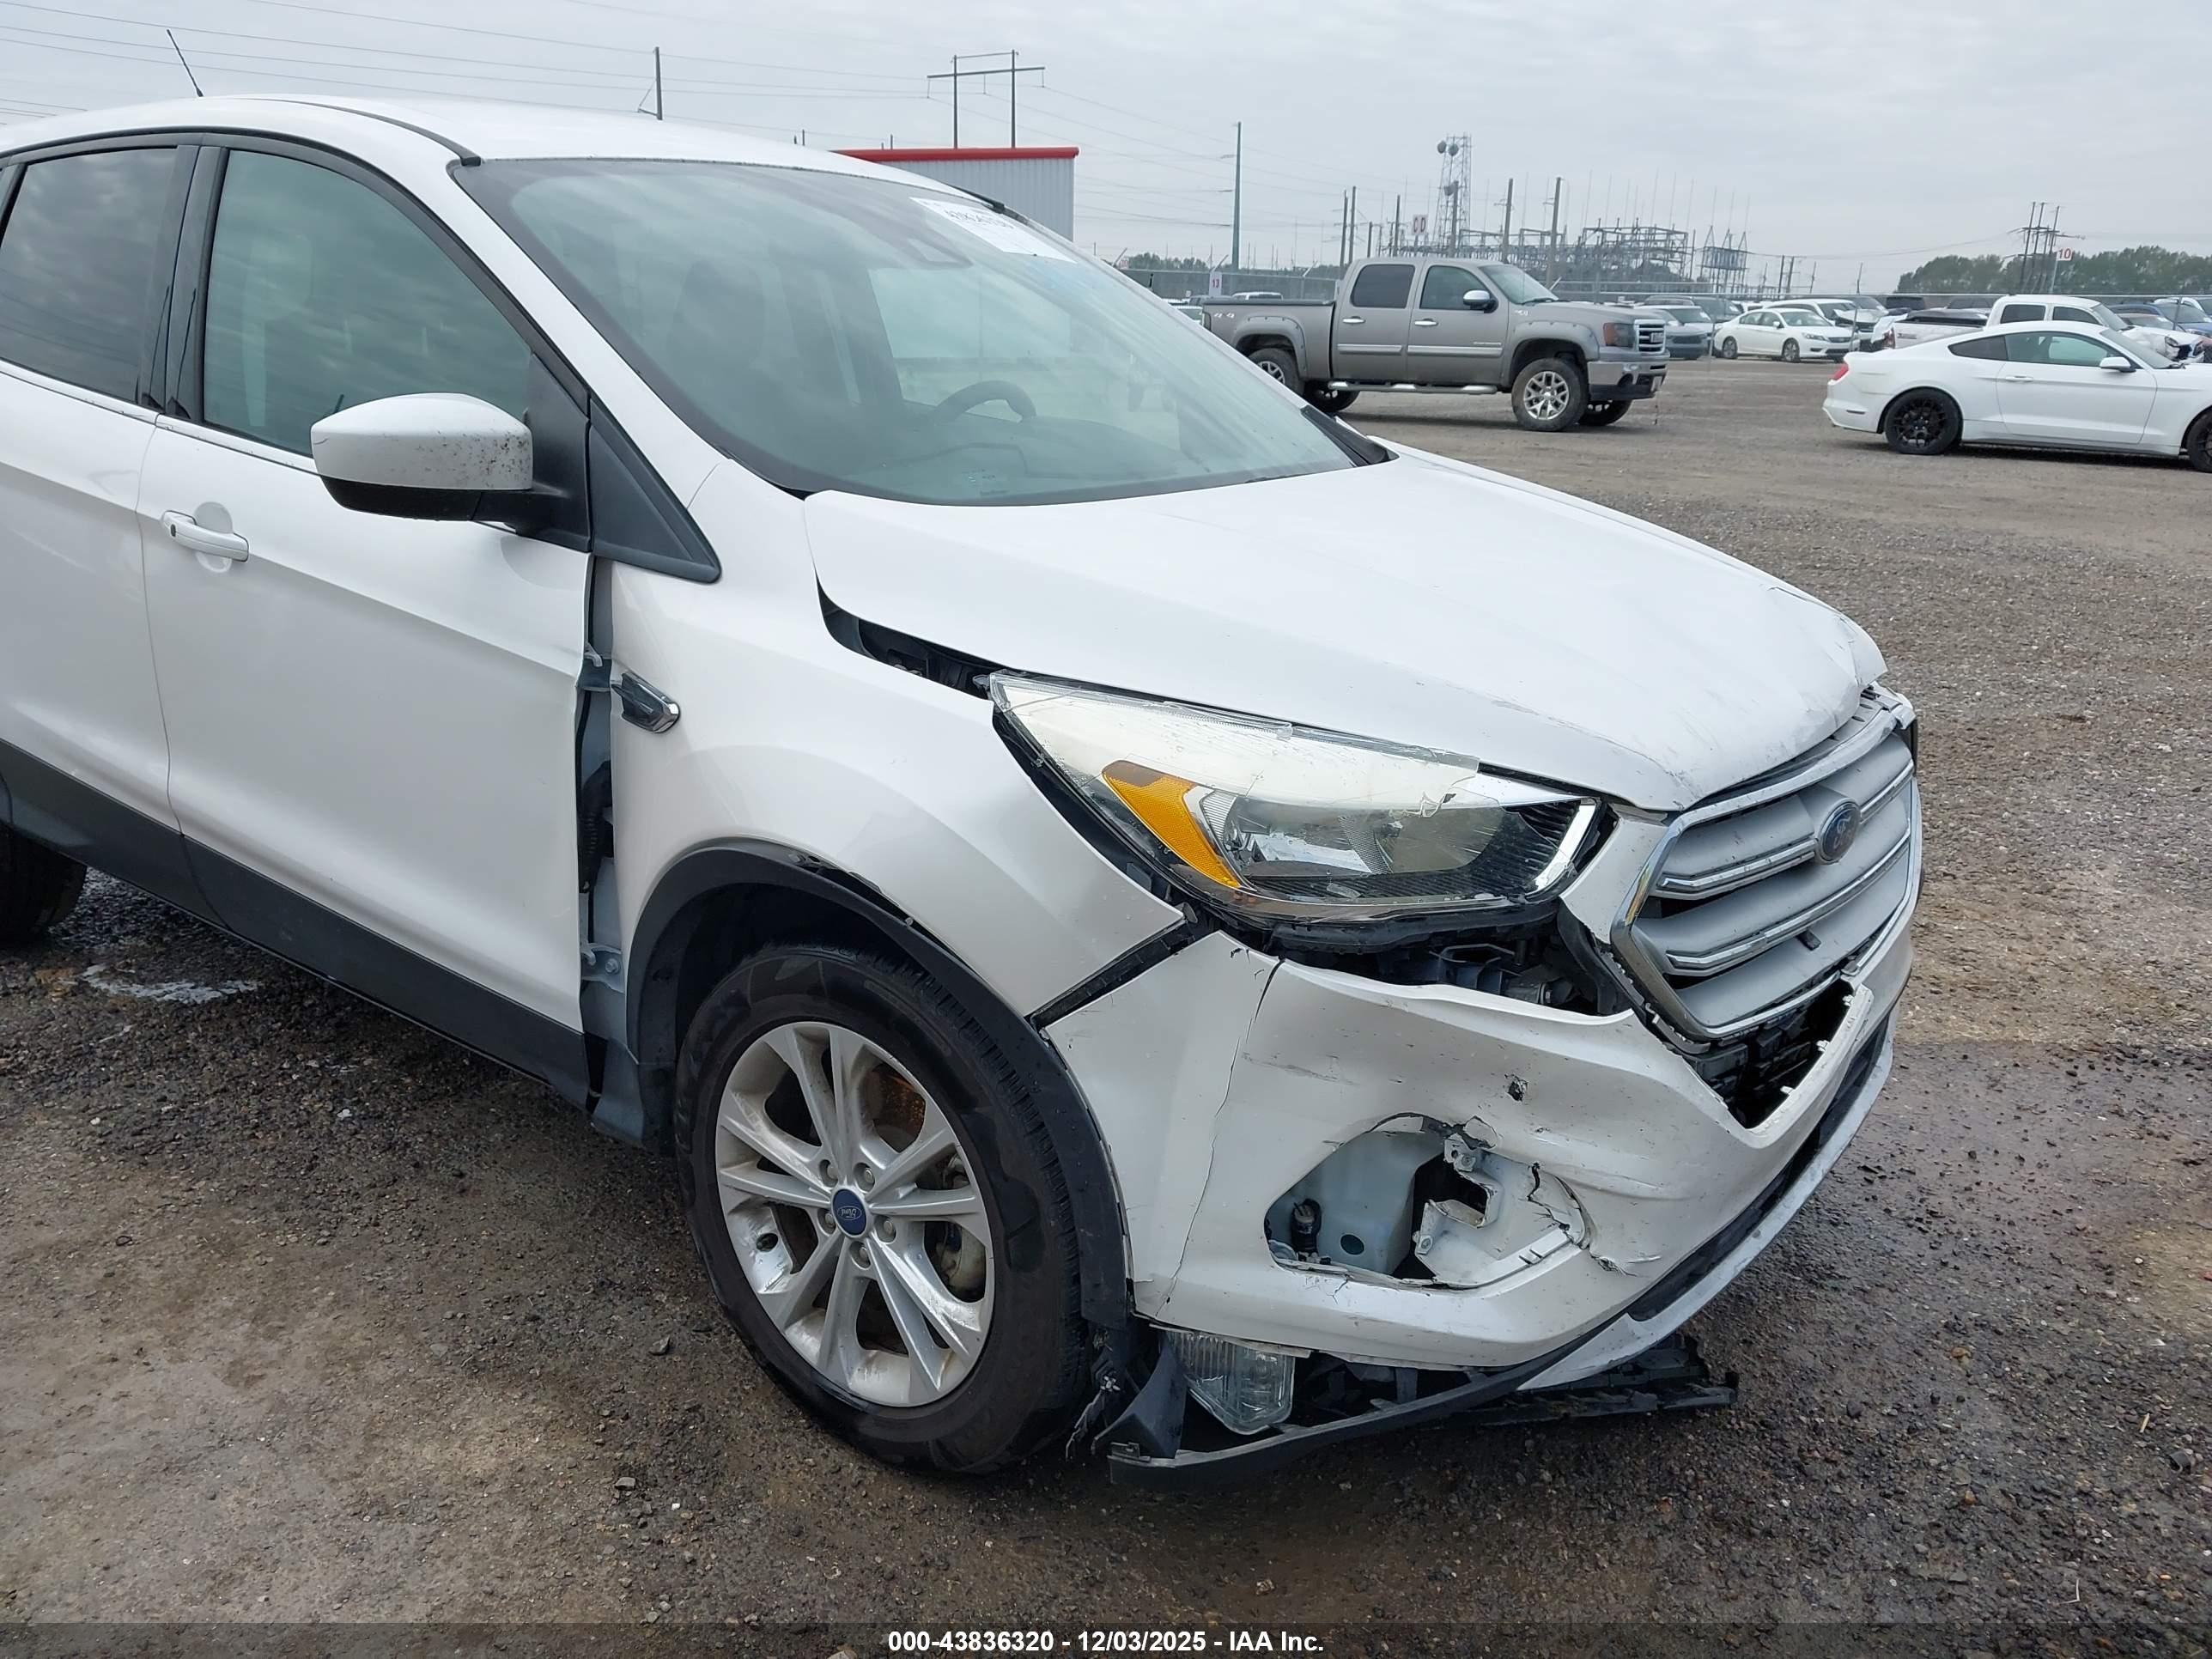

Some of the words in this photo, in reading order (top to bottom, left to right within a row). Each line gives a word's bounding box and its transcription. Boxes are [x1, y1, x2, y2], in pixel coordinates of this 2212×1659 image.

[2059, 247, 2072, 259] 10
[1212, 278, 1220, 289] 13
[841, 1207, 857, 1218] Ford
